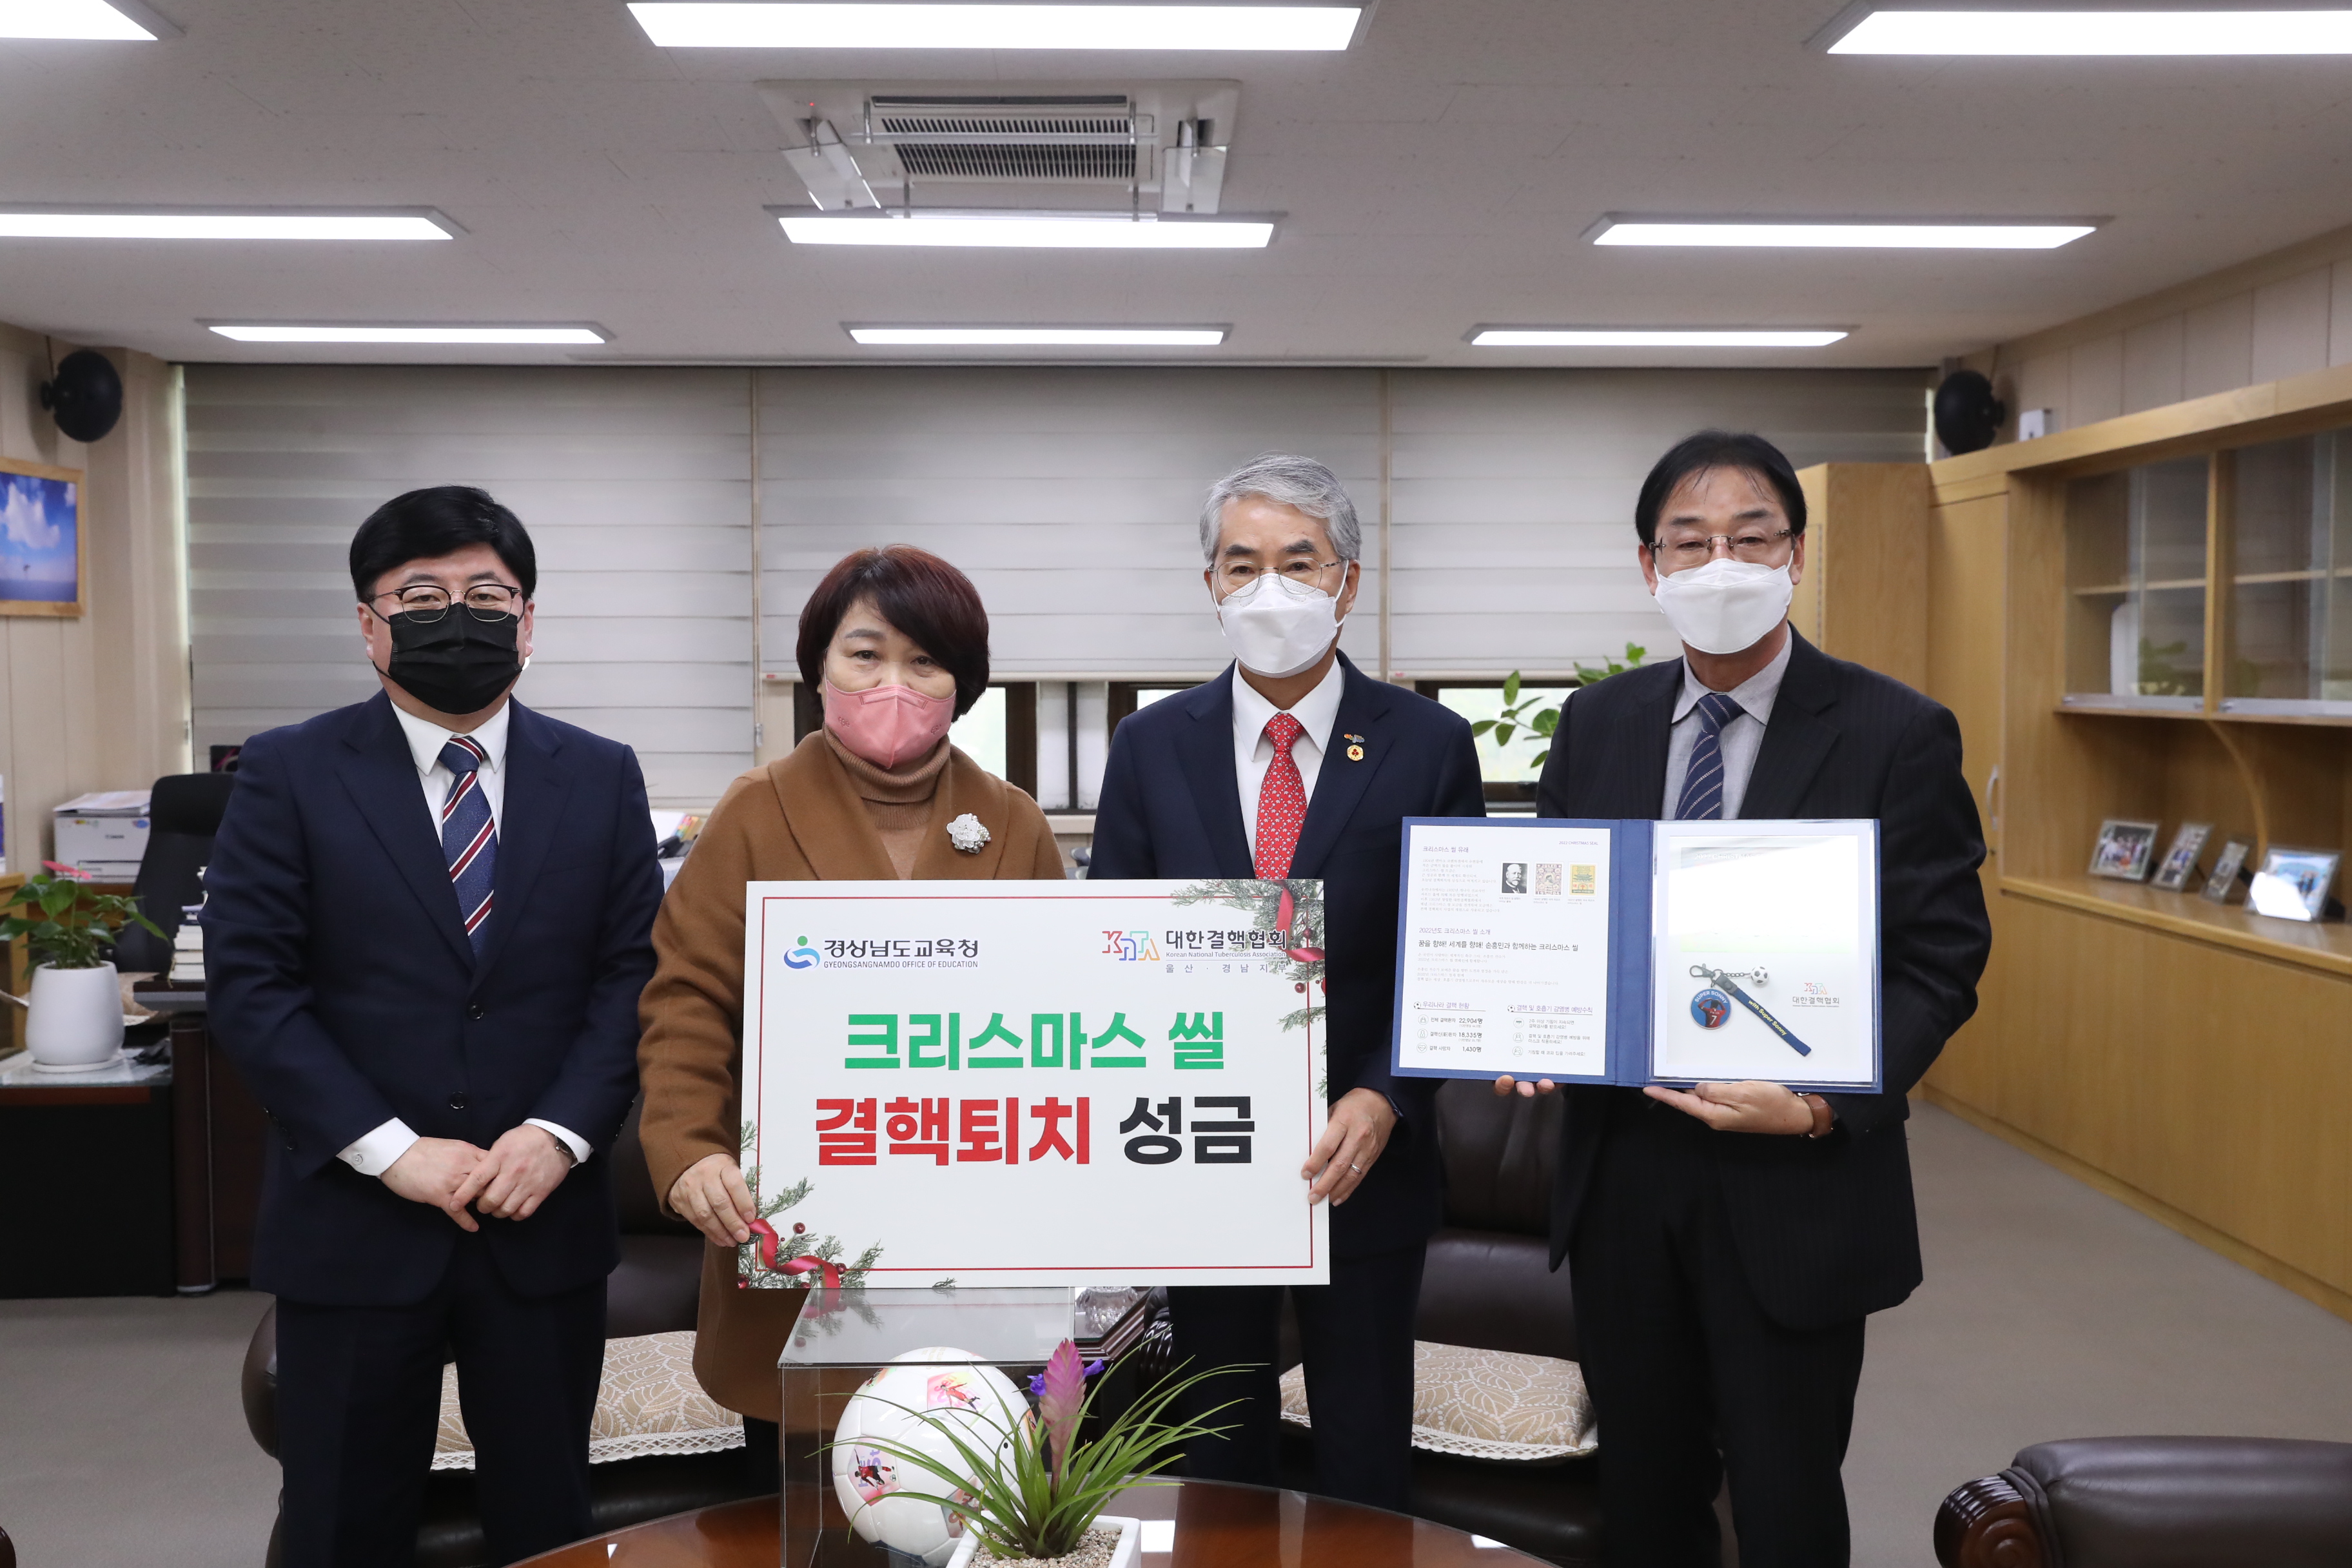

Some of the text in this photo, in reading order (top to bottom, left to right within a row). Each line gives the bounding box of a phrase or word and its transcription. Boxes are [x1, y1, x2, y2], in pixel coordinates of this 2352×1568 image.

[824, 939, 978, 958] 경상남도교육청
[1166, 930, 1287, 950] 대한결핵협회
[1469, 941, 1484, 949] 향해!
[1485, 941, 1510, 950] 손흥민과
[1512, 942, 1537, 950] 함께하는
[1694, 990, 1728, 1003] SUPER SONNY
[1792, 996, 1839, 1004] 대한결핵협회
[1709, 1015, 1718, 1025] 7
[1748, 1000, 1787, 1036] with Super Sonny
[845, 1011, 1224, 1071] 크리스마스 씰
[815, 1096, 1255, 1166] 결핵퇴치 성금
